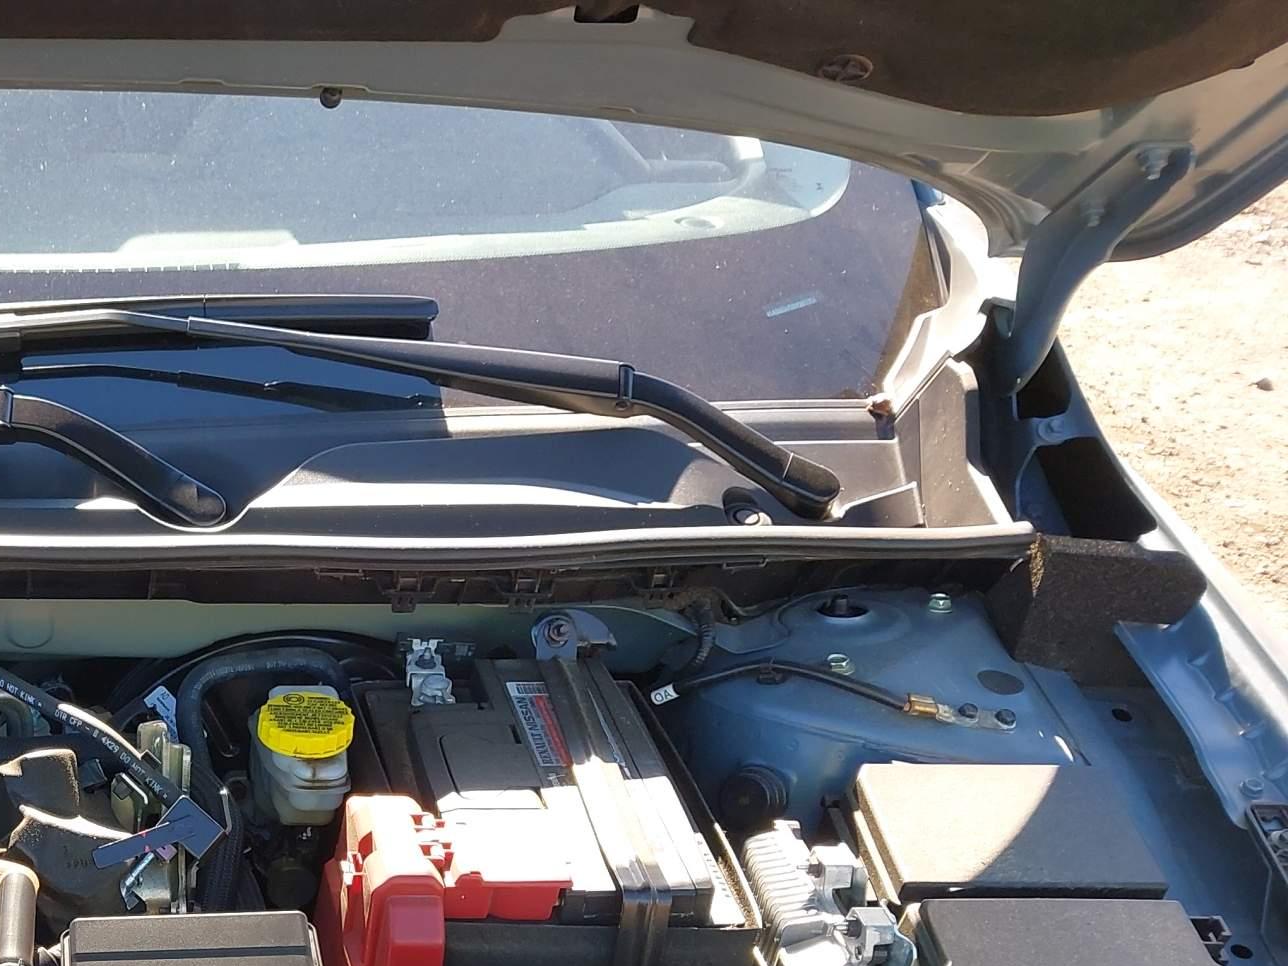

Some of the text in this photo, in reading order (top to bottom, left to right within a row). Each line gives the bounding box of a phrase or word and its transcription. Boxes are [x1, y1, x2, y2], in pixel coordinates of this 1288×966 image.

[6, 683, 19, 696] NOT
[514, 696, 540, 731] NISSAN
[119, 752, 130, 764] DO
[132, 762, 146, 775] NOT
[145, 776, 164, 795] KINK
